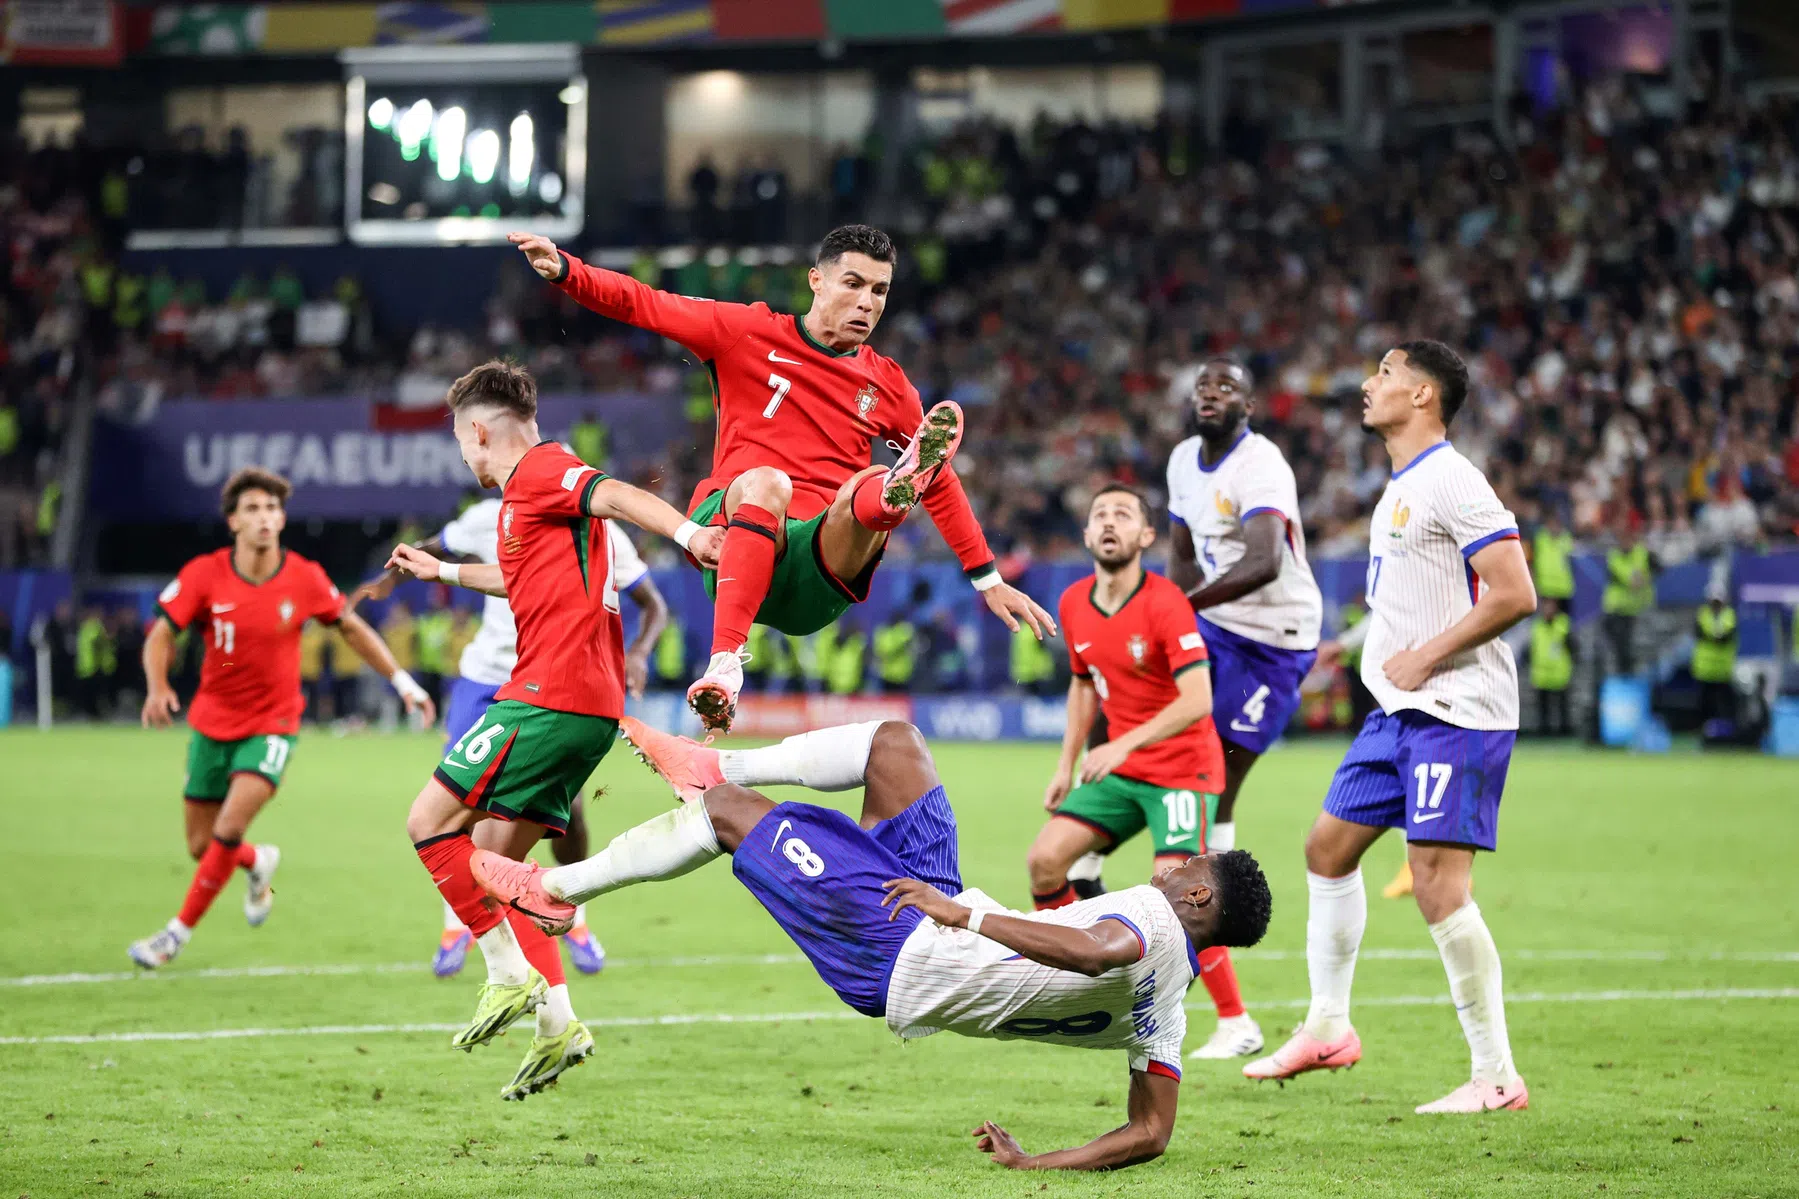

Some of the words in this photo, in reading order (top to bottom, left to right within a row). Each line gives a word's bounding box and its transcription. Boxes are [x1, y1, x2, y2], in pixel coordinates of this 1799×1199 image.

[762, 372, 792, 419] 7
[1365, 555, 1383, 598] 7
[212, 618, 235, 654] 11
[1242, 684, 1271, 725] 4
[259, 735, 289, 774] 11
[453, 713, 505, 765] 26
[1414, 762, 1453, 809] 17
[1162, 790, 1197, 832] 10
[782, 837, 825, 877] 8
[993, 1010, 1113, 1036] 8
